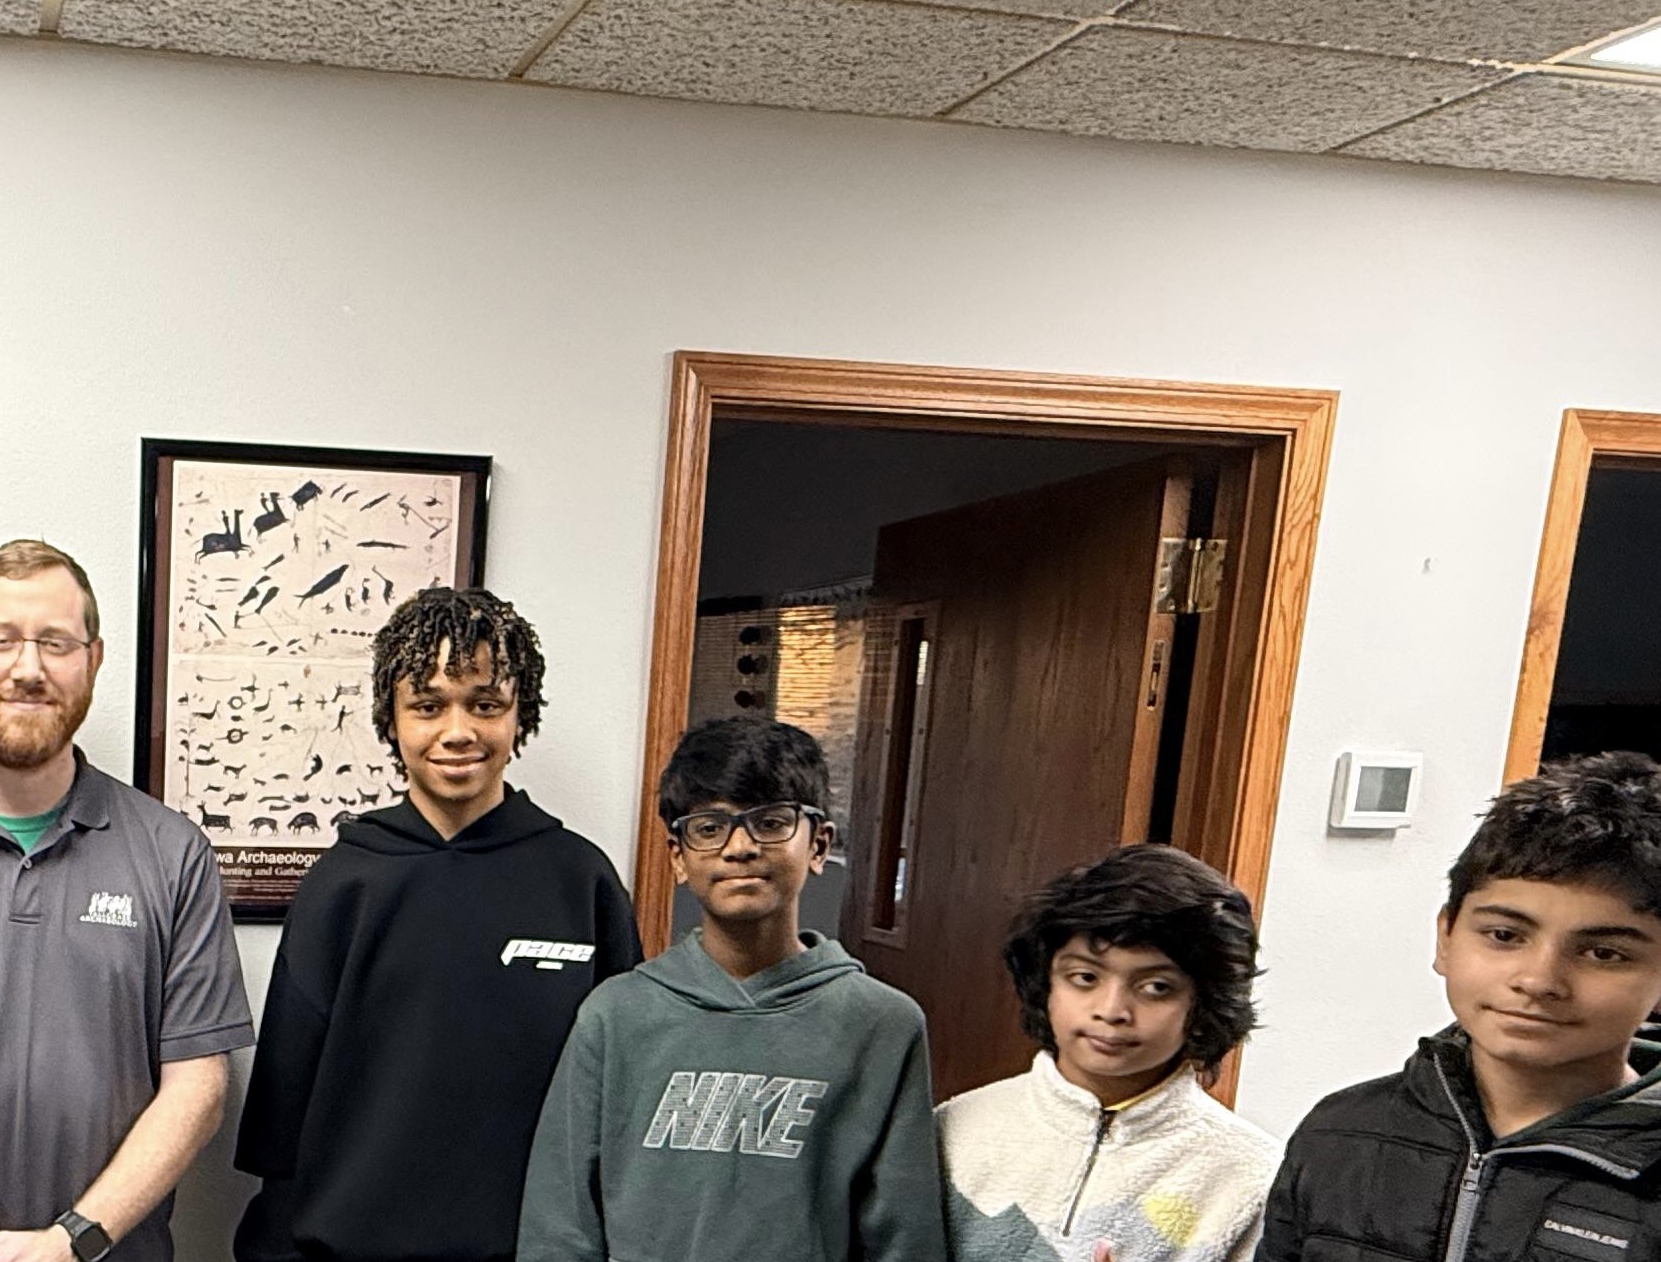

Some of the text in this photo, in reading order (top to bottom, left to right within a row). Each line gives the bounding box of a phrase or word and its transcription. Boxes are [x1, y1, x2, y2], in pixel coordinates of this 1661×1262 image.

[236, 850, 322, 867] Archaeology
[254, 866, 273, 876] and
[500, 939, 596, 966] pace
[642, 1071, 829, 1159] NIKE
